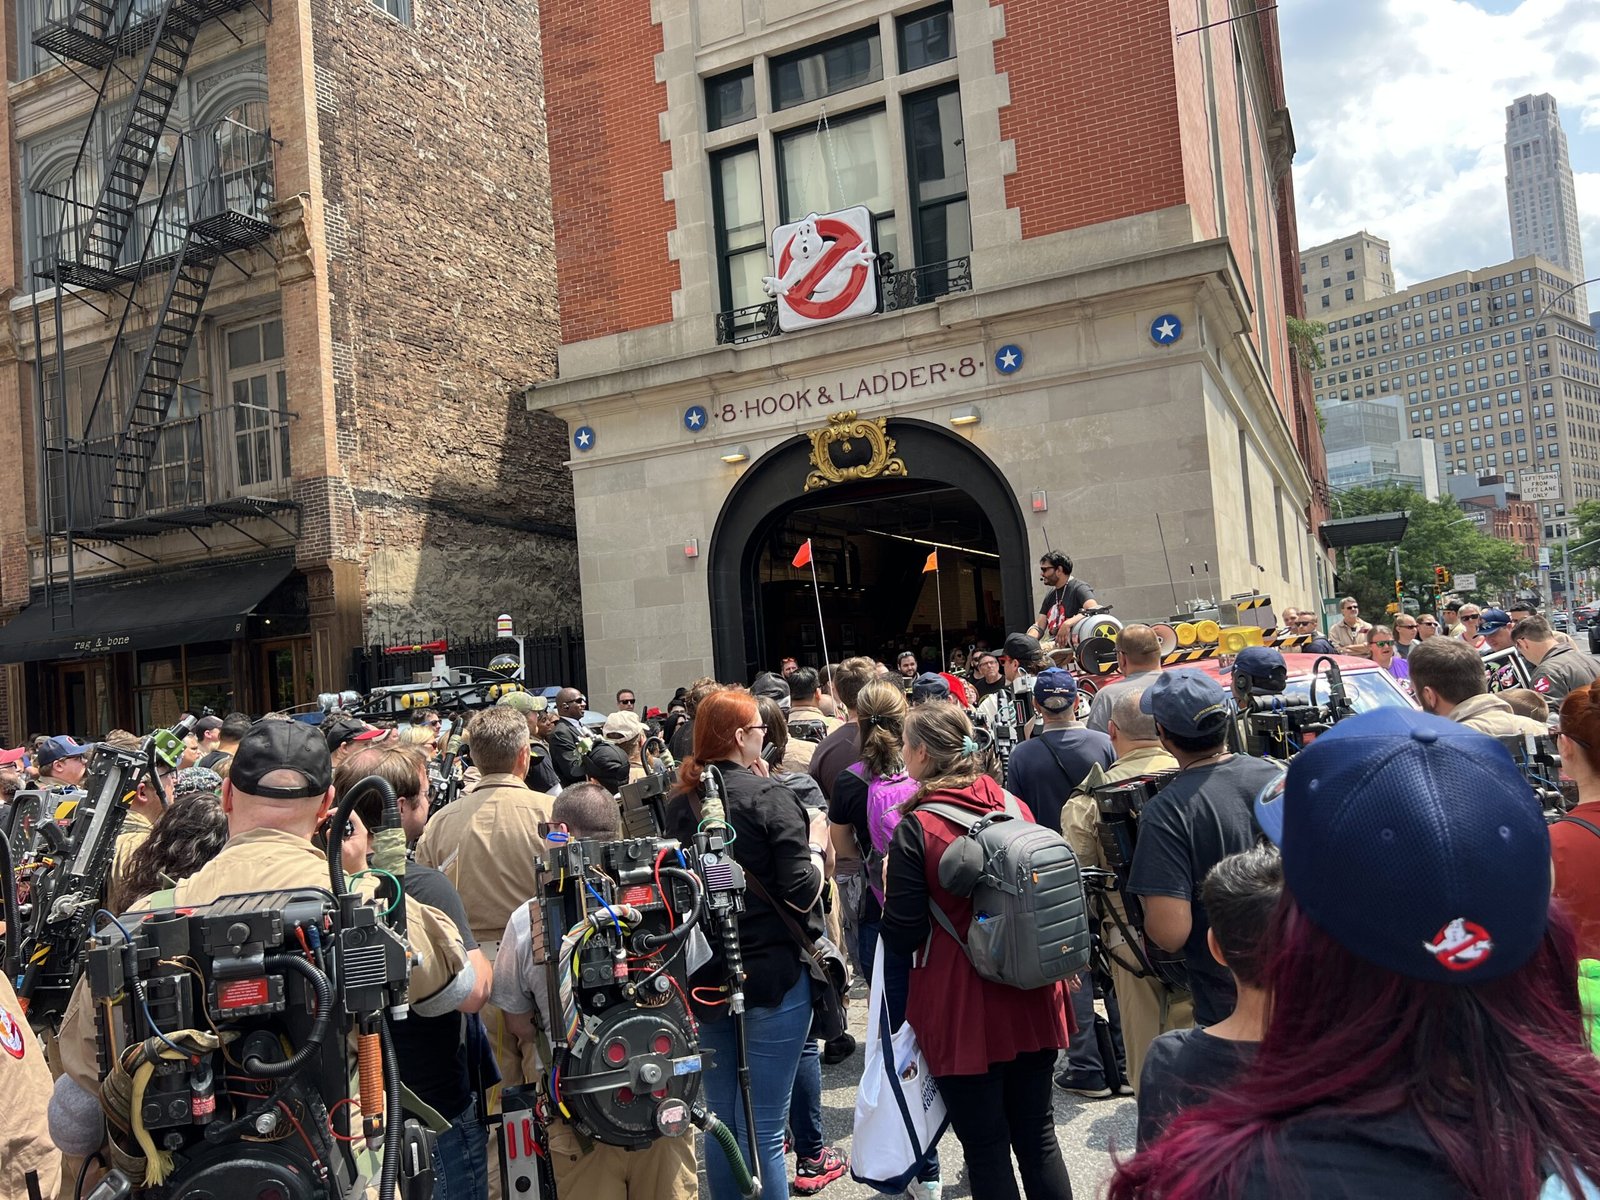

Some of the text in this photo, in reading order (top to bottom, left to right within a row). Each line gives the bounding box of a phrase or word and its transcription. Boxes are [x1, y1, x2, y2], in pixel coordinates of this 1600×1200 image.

[745, 388, 812, 419] HOOK
[817, 386, 834, 405] &
[839, 362, 947, 401] LADDER
[74, 636, 129, 650] rag & bone
